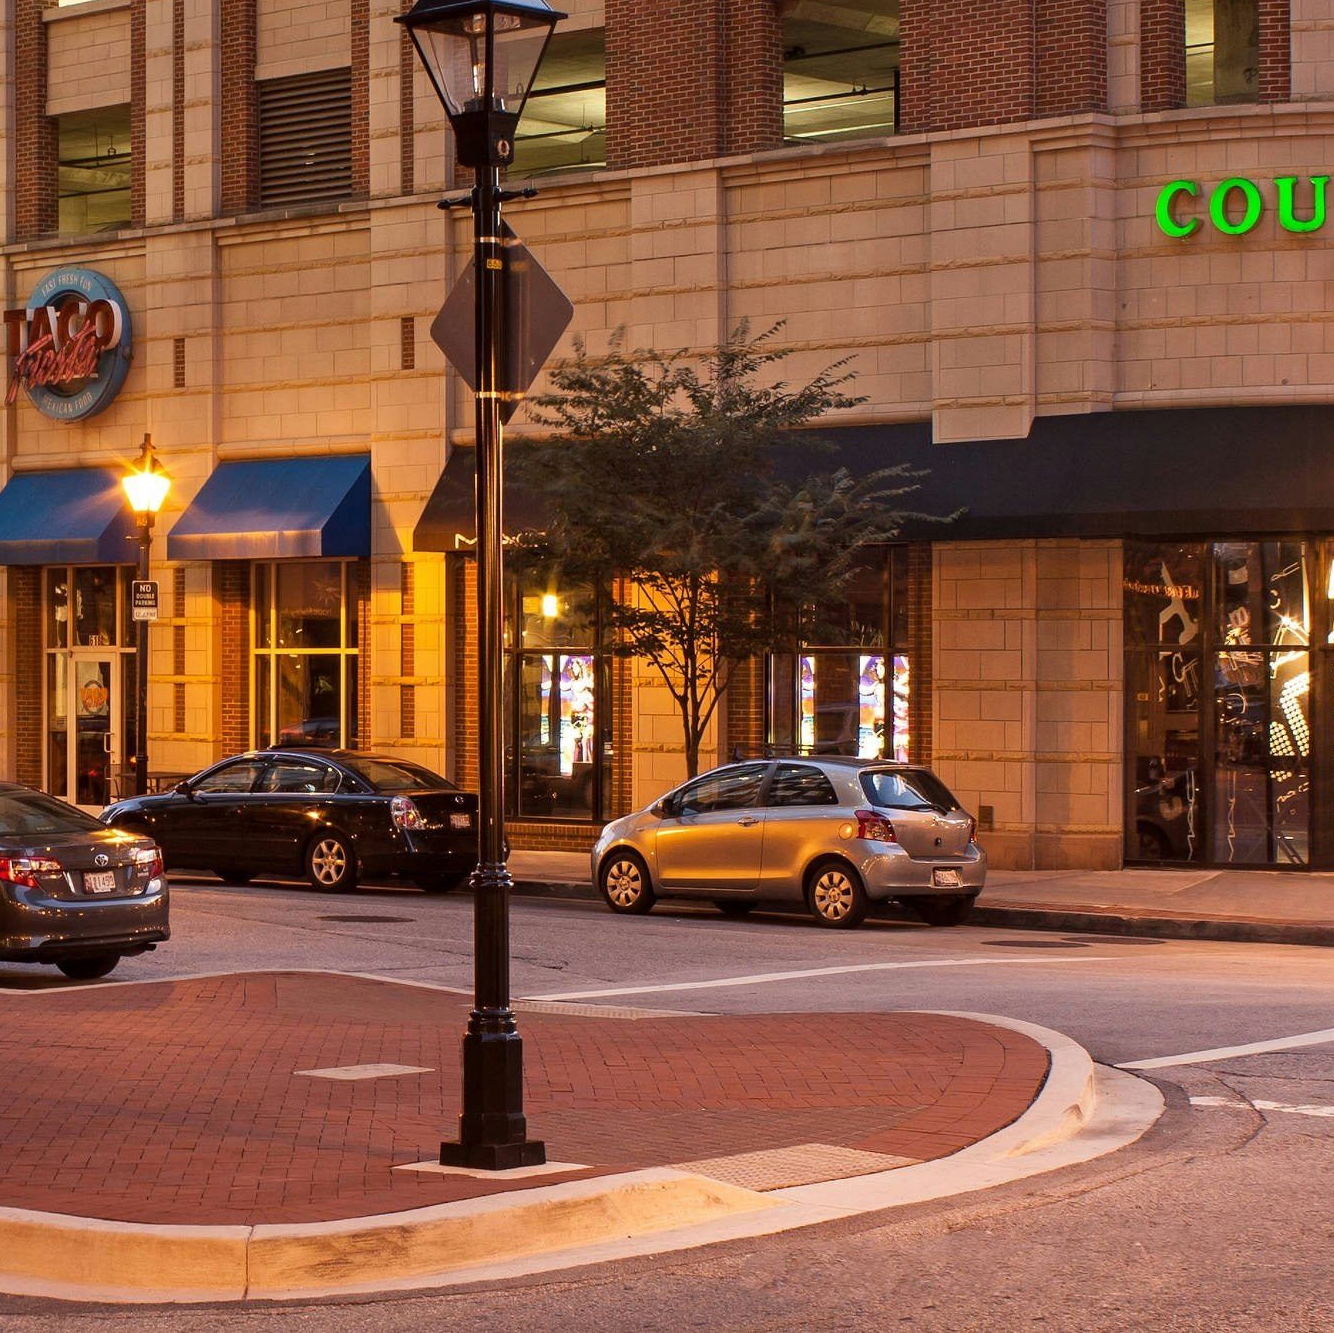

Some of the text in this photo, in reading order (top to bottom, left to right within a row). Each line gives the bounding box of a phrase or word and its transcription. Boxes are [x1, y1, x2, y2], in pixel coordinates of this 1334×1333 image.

[41, 273, 92, 297] FAST FRESH FUN
[3, 298, 123, 357] TACO
[42, 393, 93, 414] MEXICAN FOOD
[139, 584, 152, 593] NO
